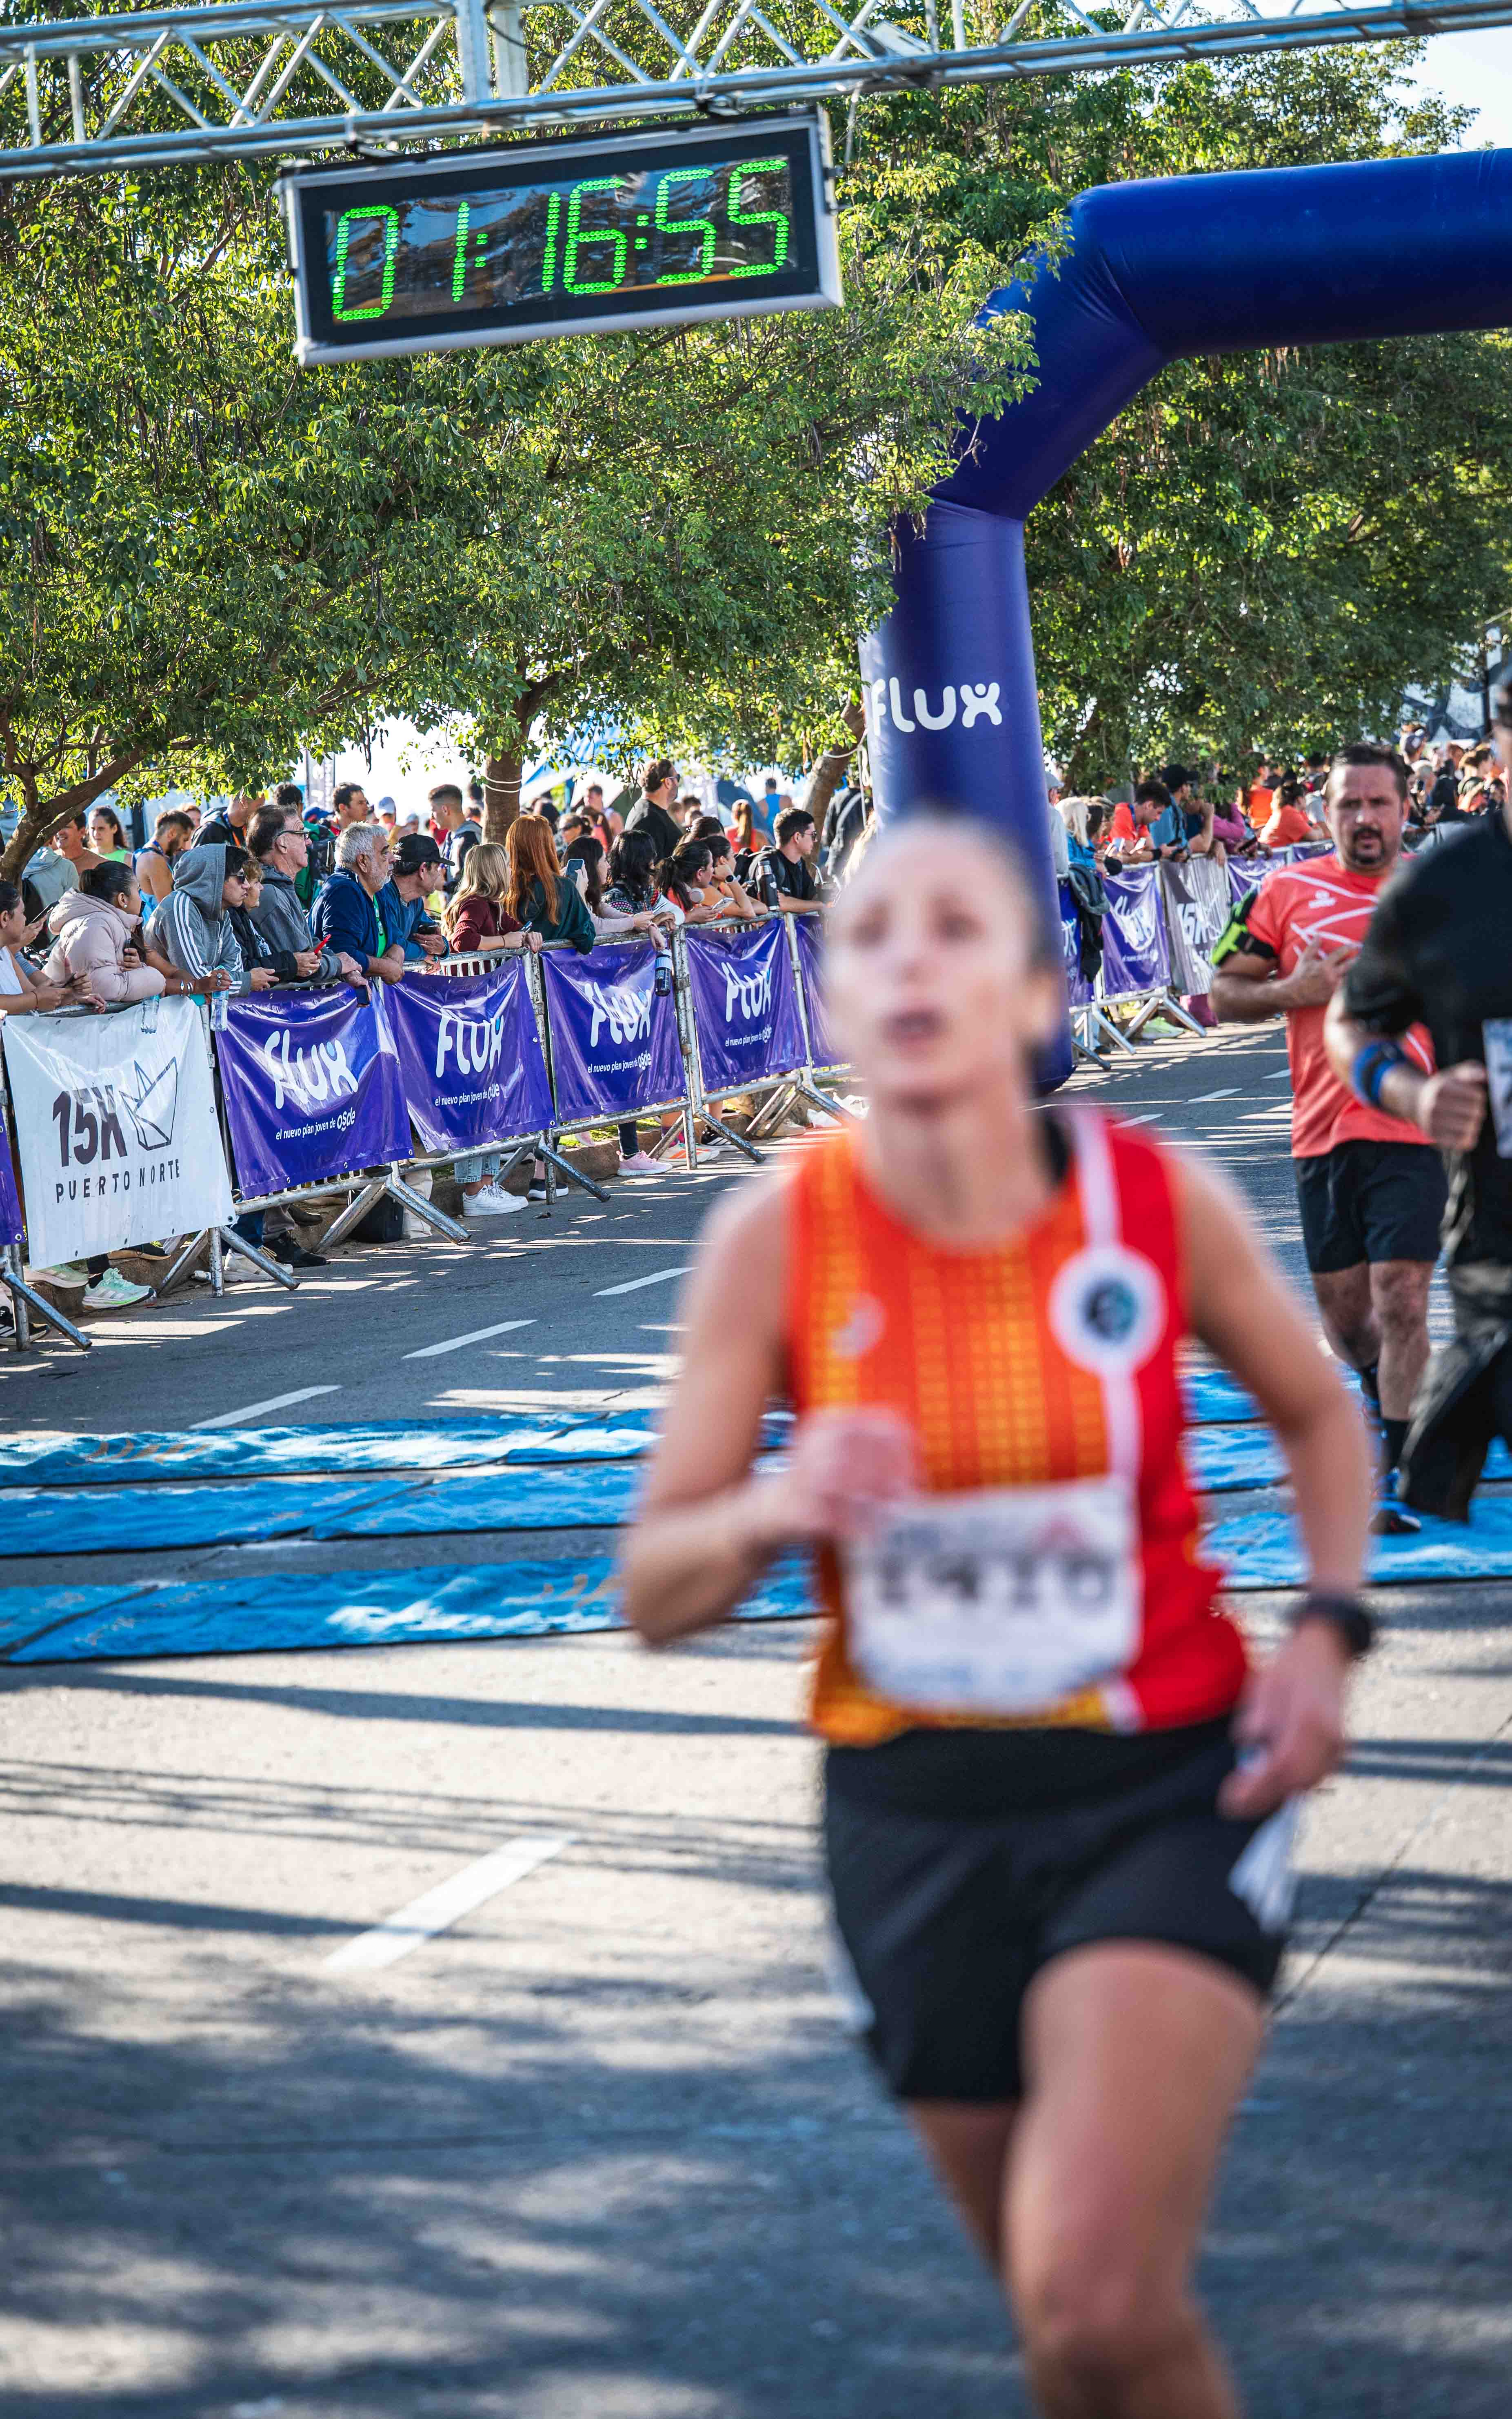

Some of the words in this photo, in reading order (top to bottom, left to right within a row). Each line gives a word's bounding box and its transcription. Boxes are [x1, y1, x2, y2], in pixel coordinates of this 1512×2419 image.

[333, 159, 788, 321] 01:16:55
[588, 1063, 593, 1073] el
[593, 1064, 610, 1072] nuevo
[611, 1061, 622, 1073] plan
[622, 1060, 634, 1072] joven
[638, 1049, 651, 1070] osde
[435, 1096, 440, 1106] el
[442, 1096, 457, 1105] nuevo
[459, 1093, 470, 1106] plan
[471, 1092, 482, 1104] joven
[483, 1089, 487, 1099] de
[53, 1085, 127, 1167] 15K
[276, 1128, 282, 1140] el
[283, 1128, 301, 1139] nuevo
[302, 1124, 314, 1138] plan
[314, 1122, 328, 1135] joven
[329, 1117, 336, 1128] de
[337, 1106, 355, 1132] osde
[56, 1171, 130, 1203] PUERTO
[139, 1159, 180, 1187] NORTE
